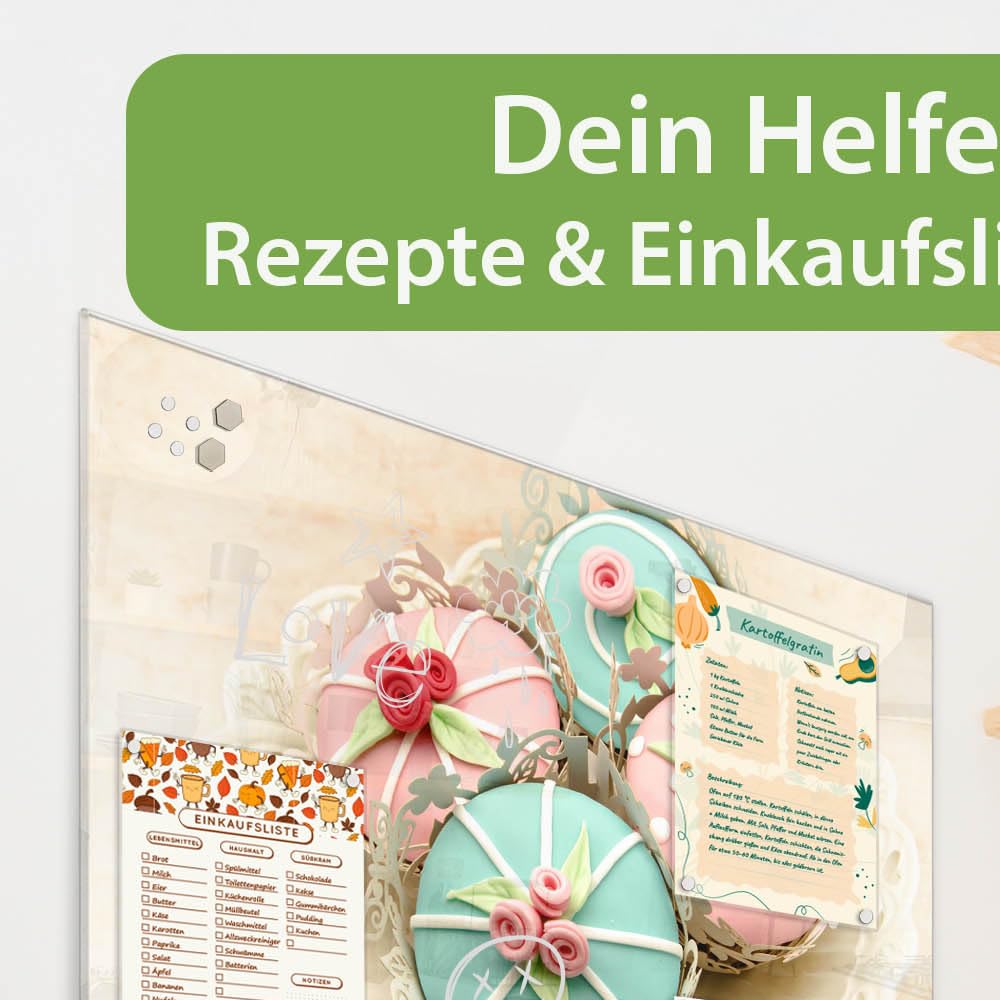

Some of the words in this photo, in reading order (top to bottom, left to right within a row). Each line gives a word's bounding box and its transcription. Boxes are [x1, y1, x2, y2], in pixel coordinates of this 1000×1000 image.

[740, 618, 824, 659] Kartoffelgratin
[194, 814, 299, 838] EINKAUFSLISTE
[149, 834, 200, 846] LEBENSMITTEL
[229, 845, 265, 855] HAUSHALT
[152, 855, 169, 863] Brot
[152, 870, 172, 878] Milch
[225, 864, 261, 875] Spülmittel
[296, 873, 332, 884] Schokolade
[225, 878, 277, 892] Toilettenpapier
[296, 887, 314, 896] Kekse
[152, 898, 176, 906] Butter
[225, 892, 265, 903] Küchenrolle
[225, 906, 260, 916] Müllbeutel
[296, 900, 346, 913] Gummibärchen
[225, 919, 268, 930] Waschmittel
[296, 914, 323, 925] Pudding
[152, 926, 185, 934] Karotten
[296, 927, 320, 936] Kuchen
[225, 933, 280, 946] Allzweckreiniger
[152, 940, 180, 950] Paprika
[152, 954, 171, 962] Salat
[225, 961, 257, 971] Batterien
[152, 968, 171, 977] Äpfel
[302, 977, 331, 985] NOTIZEN
[152, 982, 184, 991] Bananen
